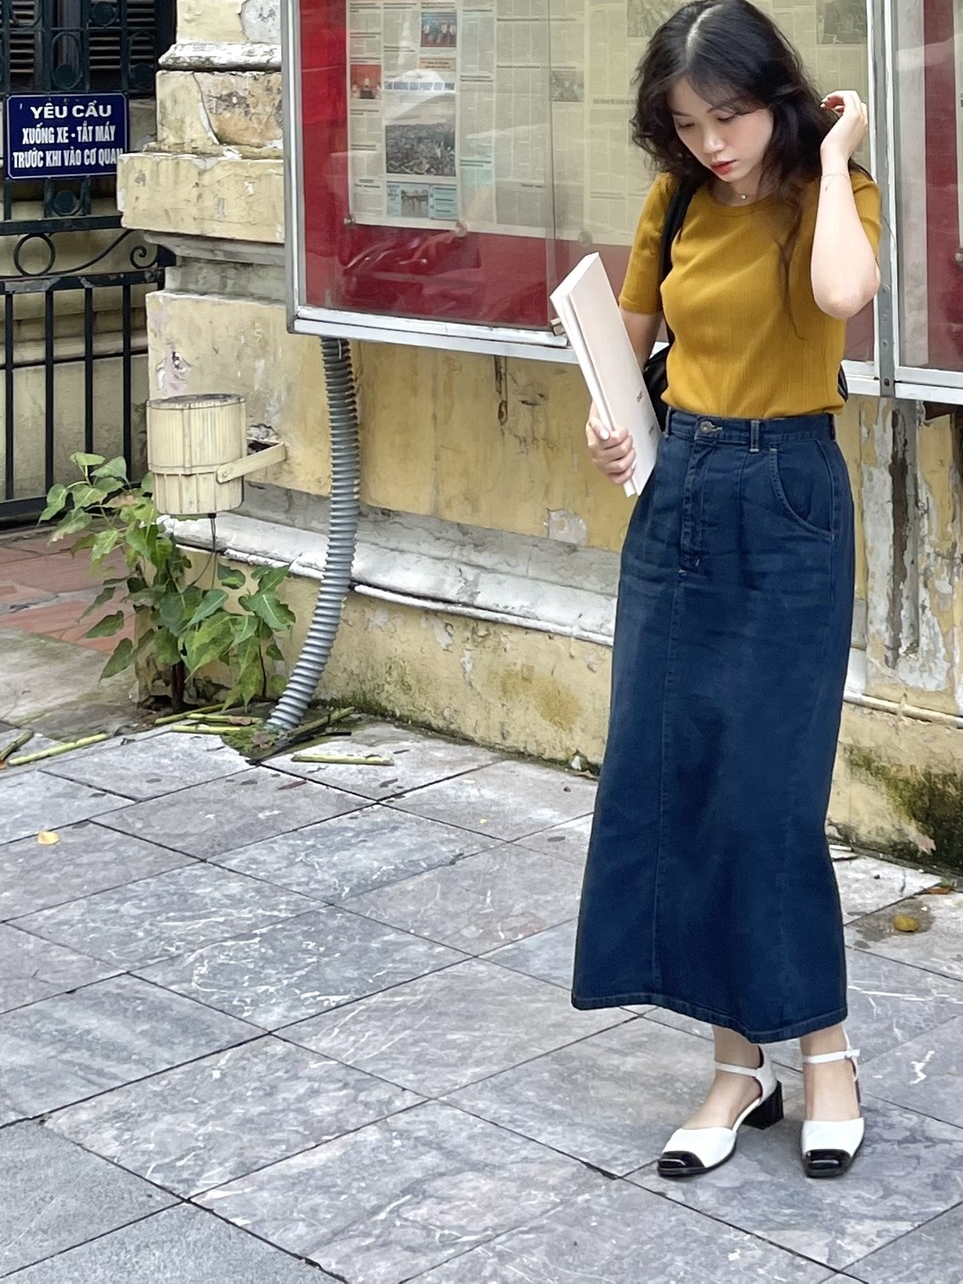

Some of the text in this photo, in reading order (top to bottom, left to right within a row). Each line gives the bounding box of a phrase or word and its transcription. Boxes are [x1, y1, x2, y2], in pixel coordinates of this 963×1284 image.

[30, 100, 112, 119] YÊU CẦU
[22, 122, 55, 144] XUỐNG
[57, 126, 69, 144] XE
[95, 120, 116, 142] MÁY
[13, 147, 44, 168] TRƯỚC
[46, 150, 62, 167] KHI
[64, 146, 82, 166] VÀO
[84, 148, 97, 166] CƠ
